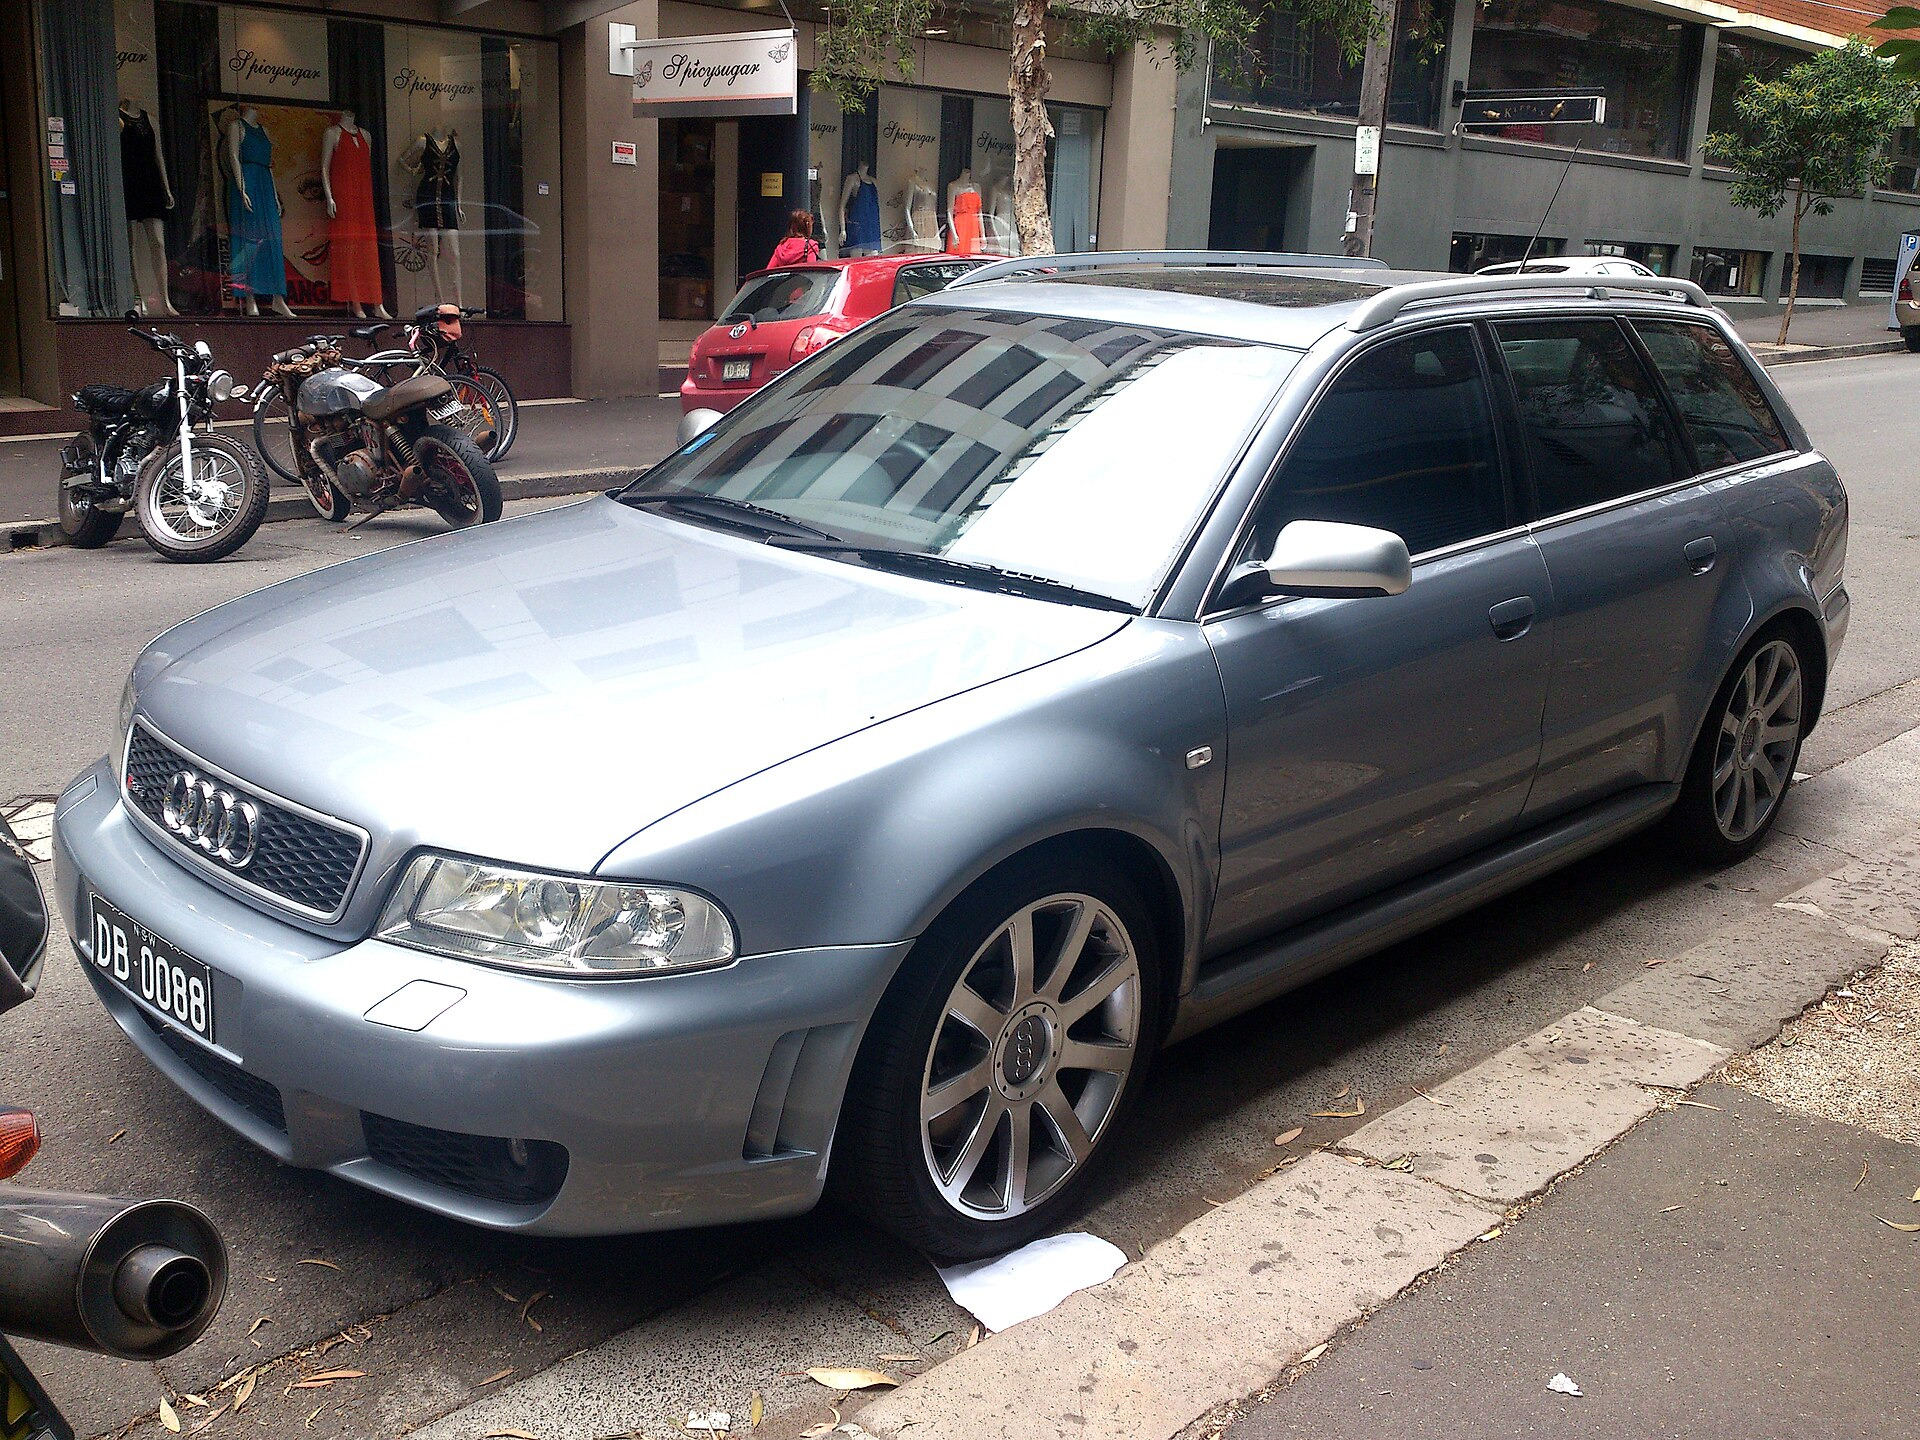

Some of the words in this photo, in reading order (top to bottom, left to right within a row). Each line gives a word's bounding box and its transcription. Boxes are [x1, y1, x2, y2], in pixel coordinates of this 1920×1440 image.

[228, 49, 321, 87] Spicysugar
[662, 54, 761, 88] Spicysugar
[393, 67, 476, 102] Spicysugar
[882, 120, 937, 149] Spicysugar
[1907, 236, 1916, 248] P
[133, 923, 156, 948] NSW
